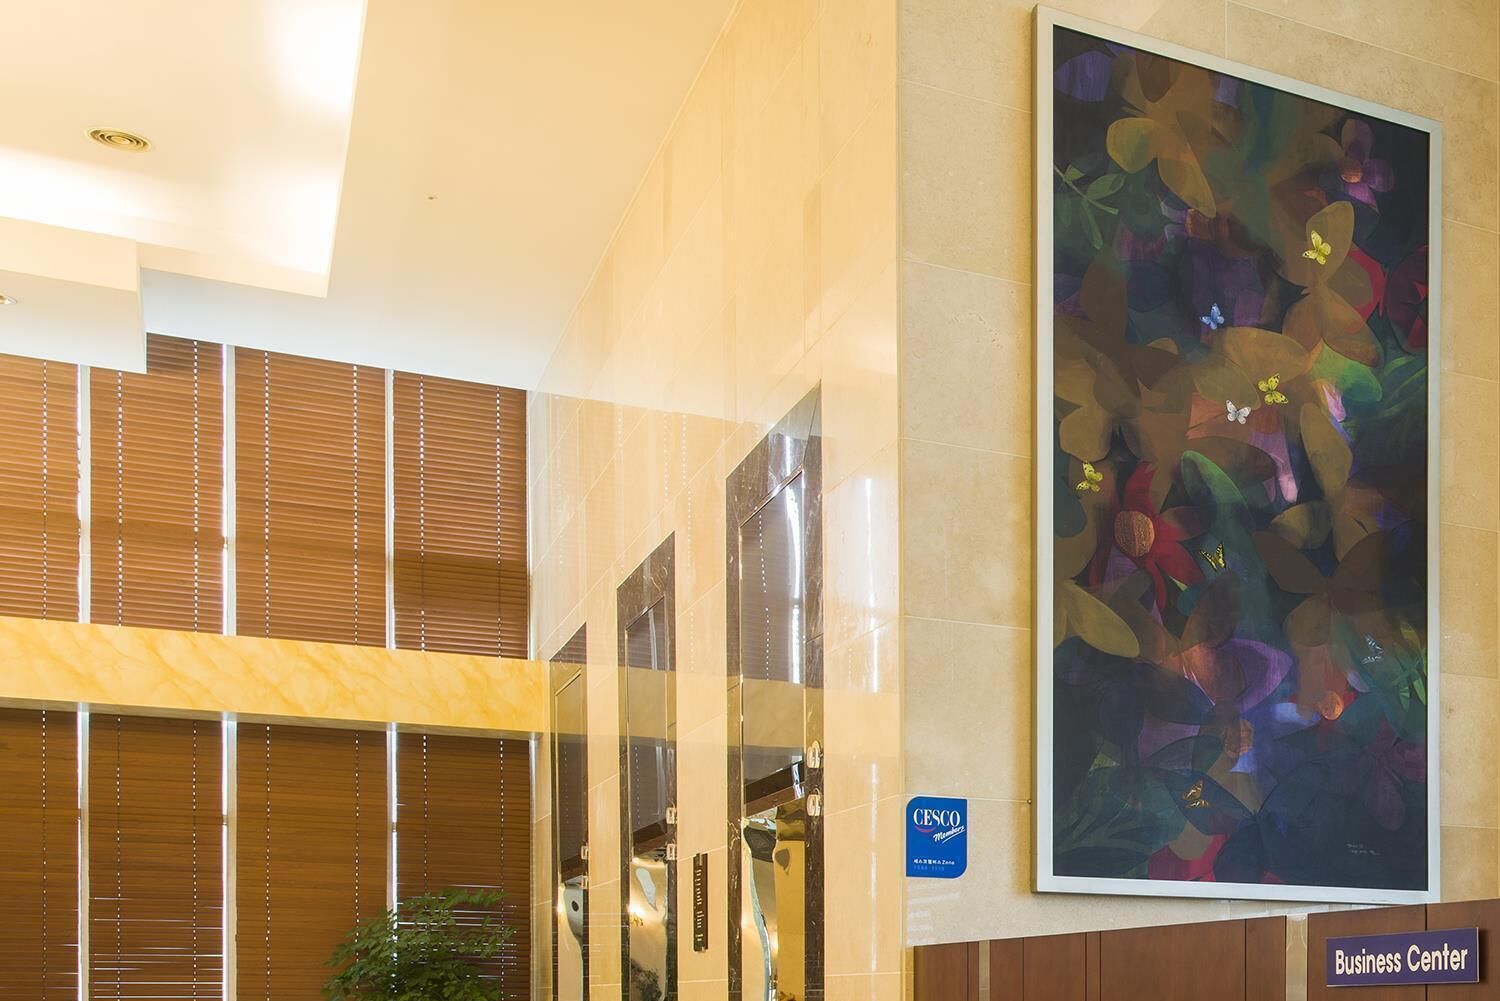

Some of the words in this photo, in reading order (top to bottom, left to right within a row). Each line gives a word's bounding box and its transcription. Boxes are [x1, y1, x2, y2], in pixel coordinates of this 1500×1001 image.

[913, 808, 961, 827] CESCO
[933, 825, 965, 842] Members
[1335, 949, 1402, 975] Business
[1407, 943, 1468, 972] Center
